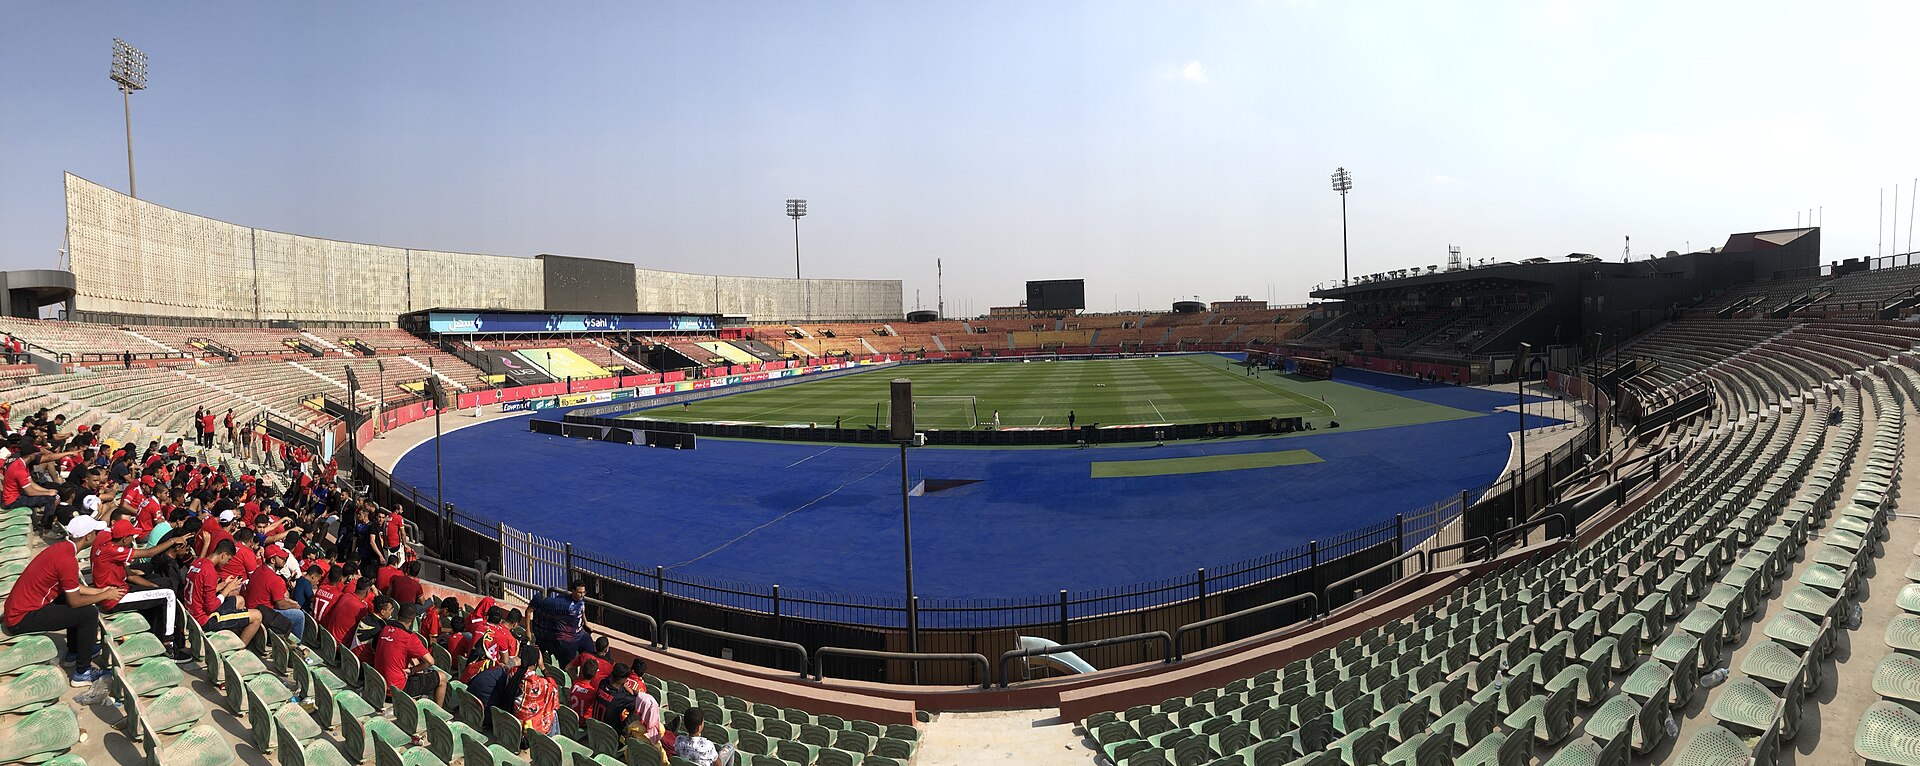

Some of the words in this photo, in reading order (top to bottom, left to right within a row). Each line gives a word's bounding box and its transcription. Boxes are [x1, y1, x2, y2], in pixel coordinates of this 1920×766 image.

[448, 317, 475, 332] سهل
[590, 318, 607, 328] Sahl
[630, 397, 668, 409] Presentation
[313, 597, 330, 621] 17
